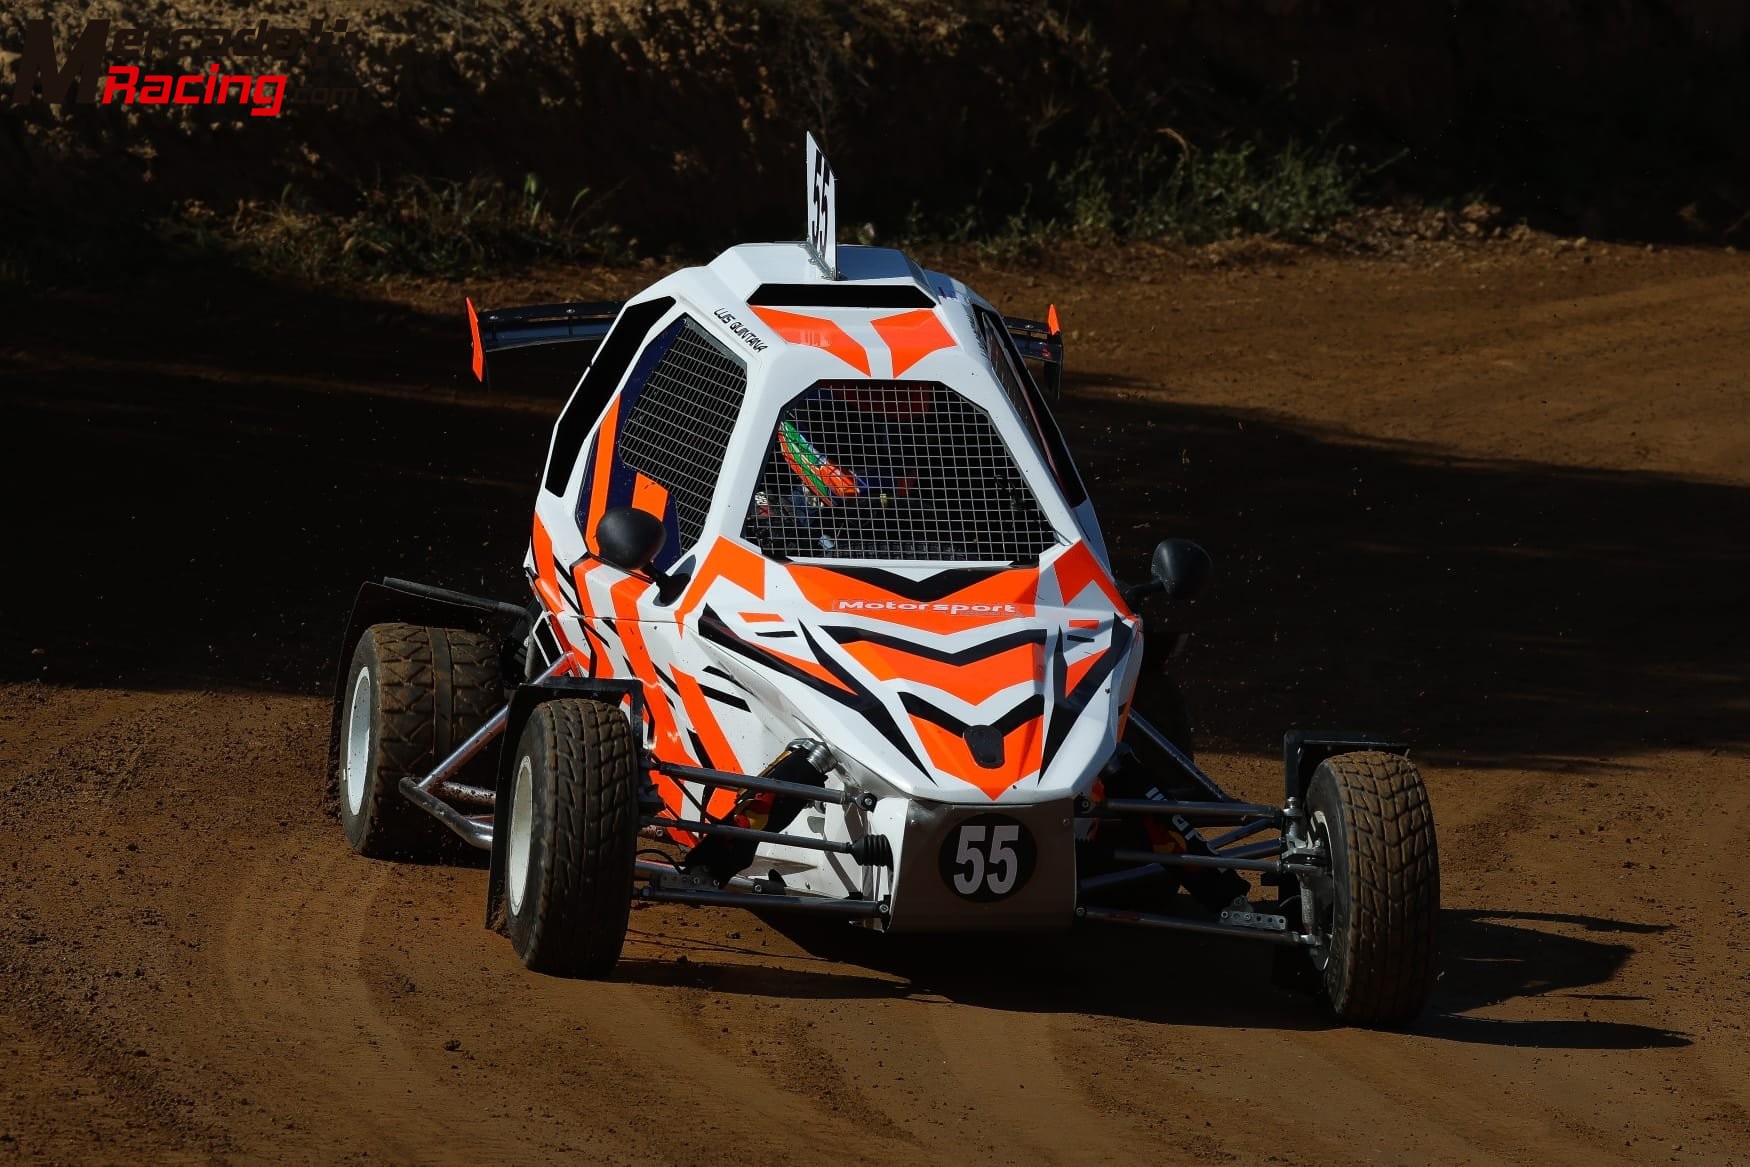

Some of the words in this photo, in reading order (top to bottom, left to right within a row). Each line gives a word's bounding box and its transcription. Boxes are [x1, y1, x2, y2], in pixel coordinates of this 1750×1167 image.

[812, 148, 830, 261] 55
[838, 601, 1017, 615] Motorsport
[953, 825, 1020, 895] 55
